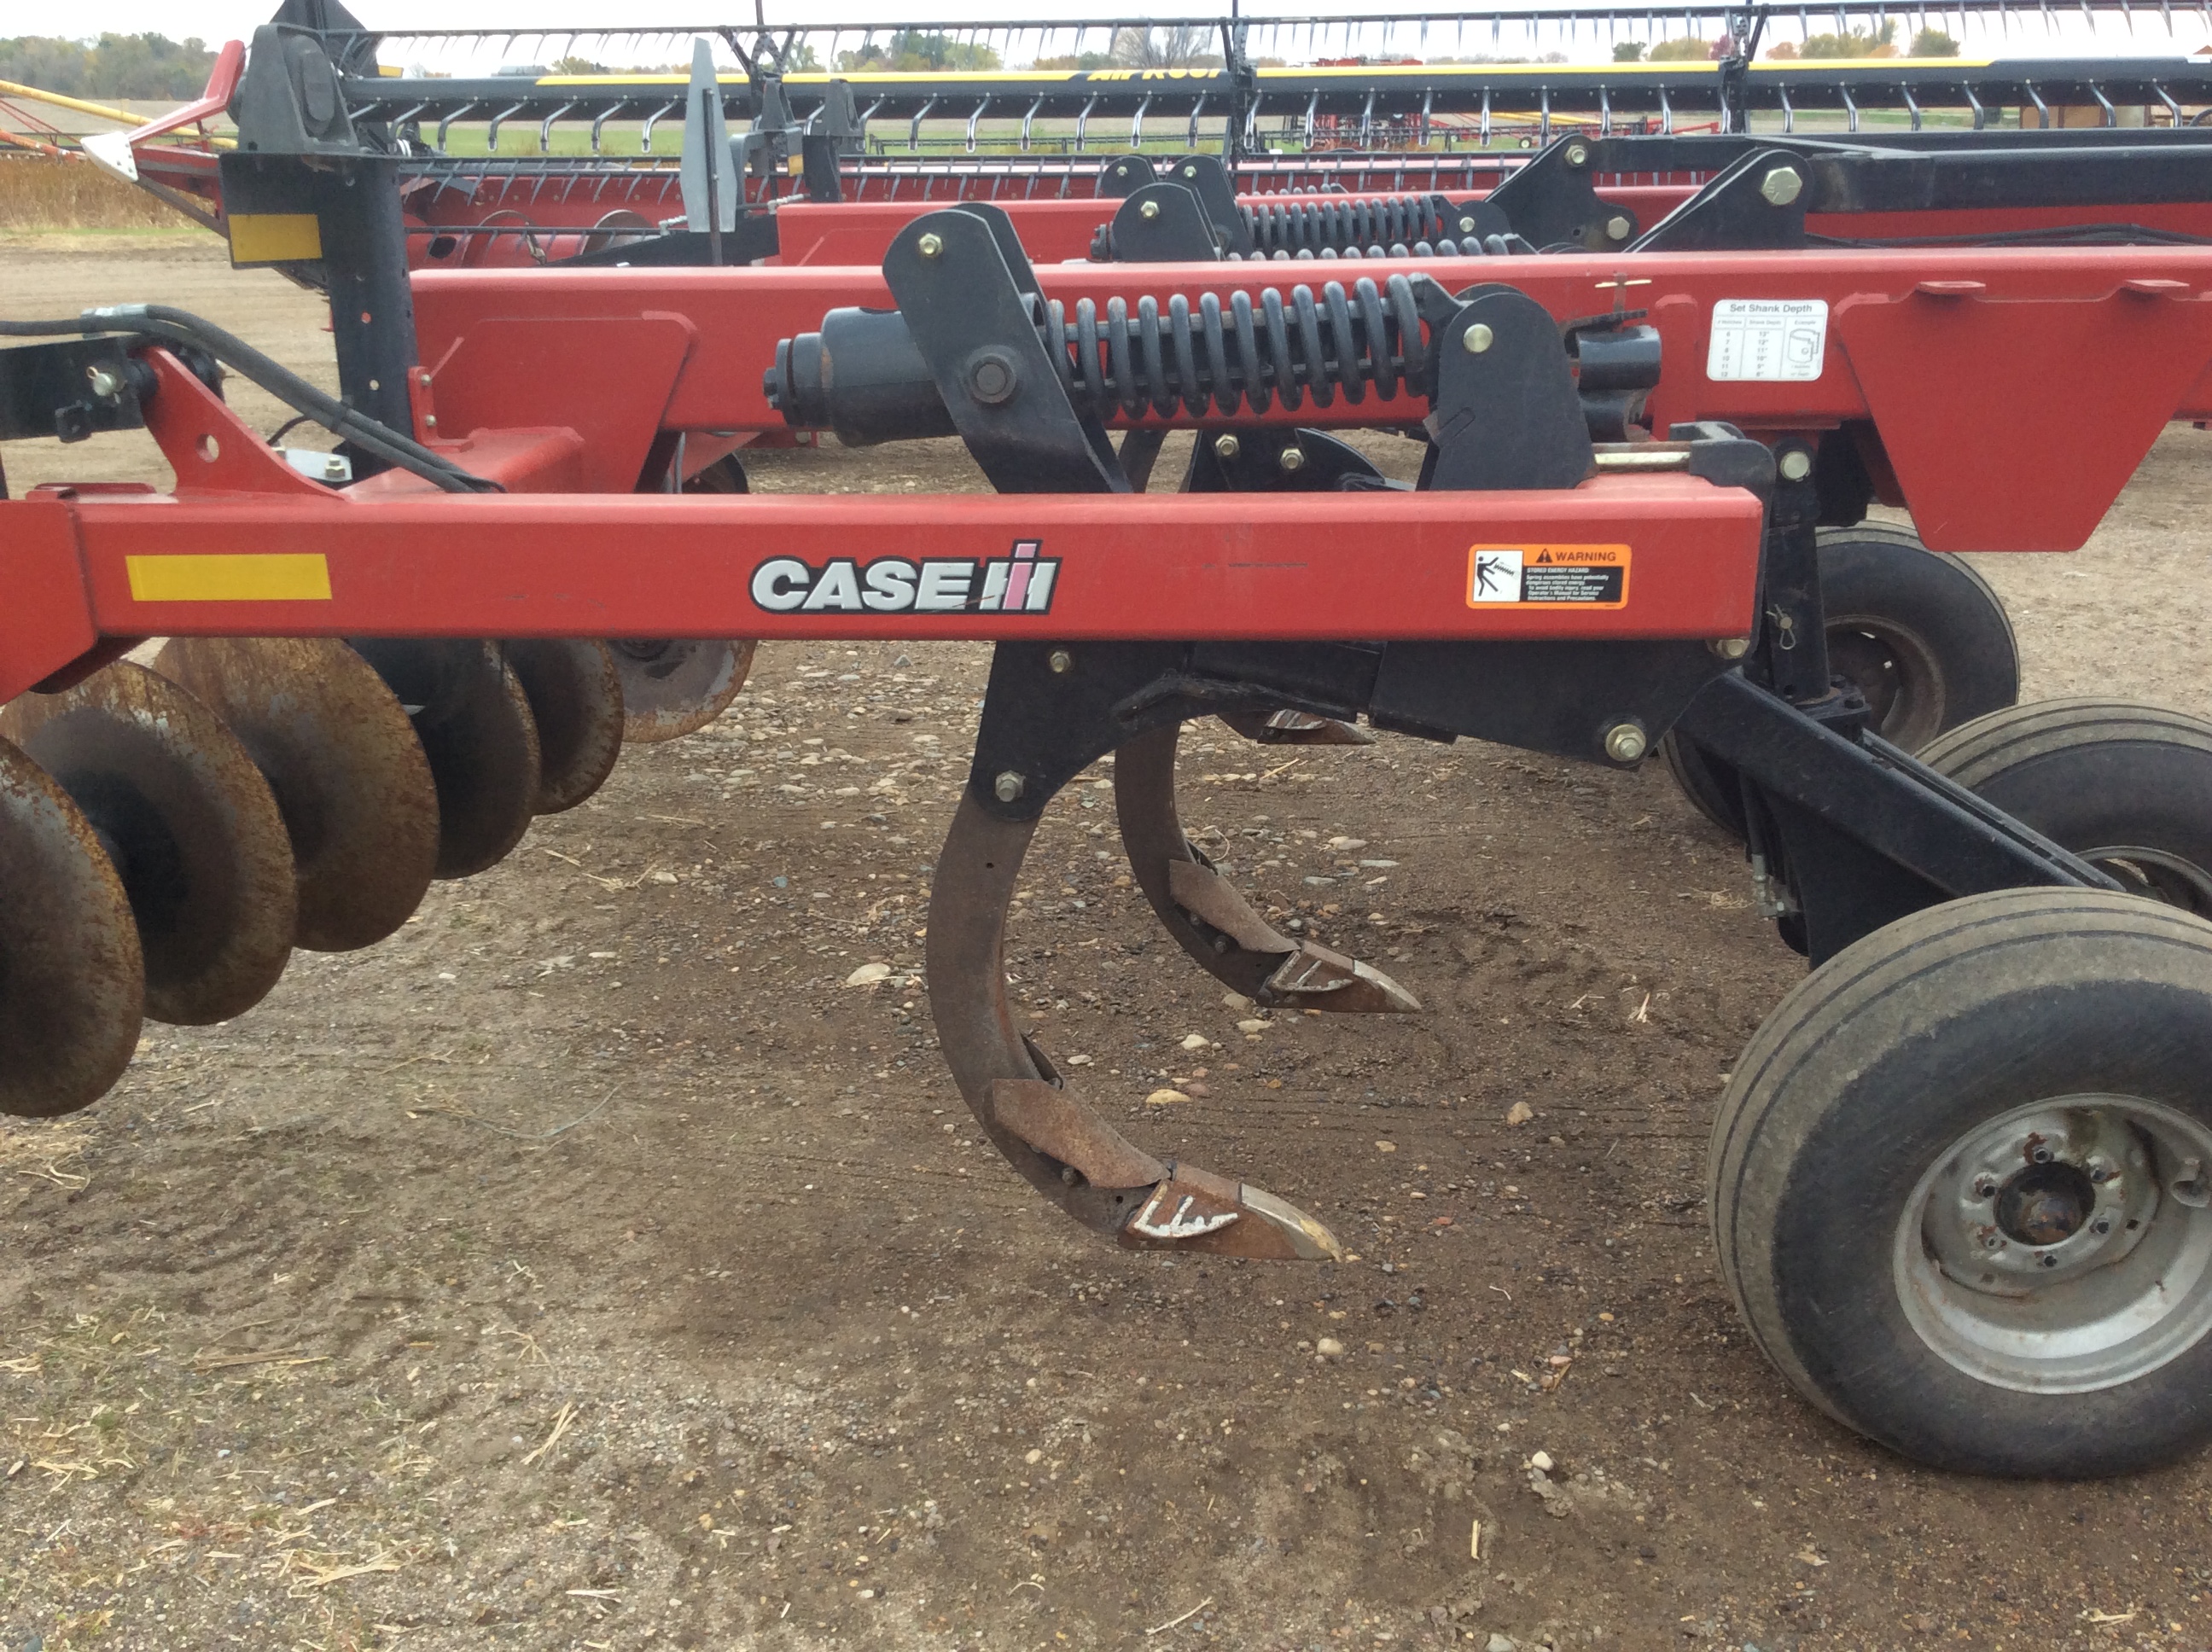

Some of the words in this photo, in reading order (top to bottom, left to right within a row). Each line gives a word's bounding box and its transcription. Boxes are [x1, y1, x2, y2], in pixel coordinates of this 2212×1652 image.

[1730, 304, 1745, 312] Set
[1749, 304, 1780, 312] Shank
[1784, 305, 1813, 313] Depth
[1555, 551, 1616, 561] WARNING
[752, 559, 976, 611] CASE
